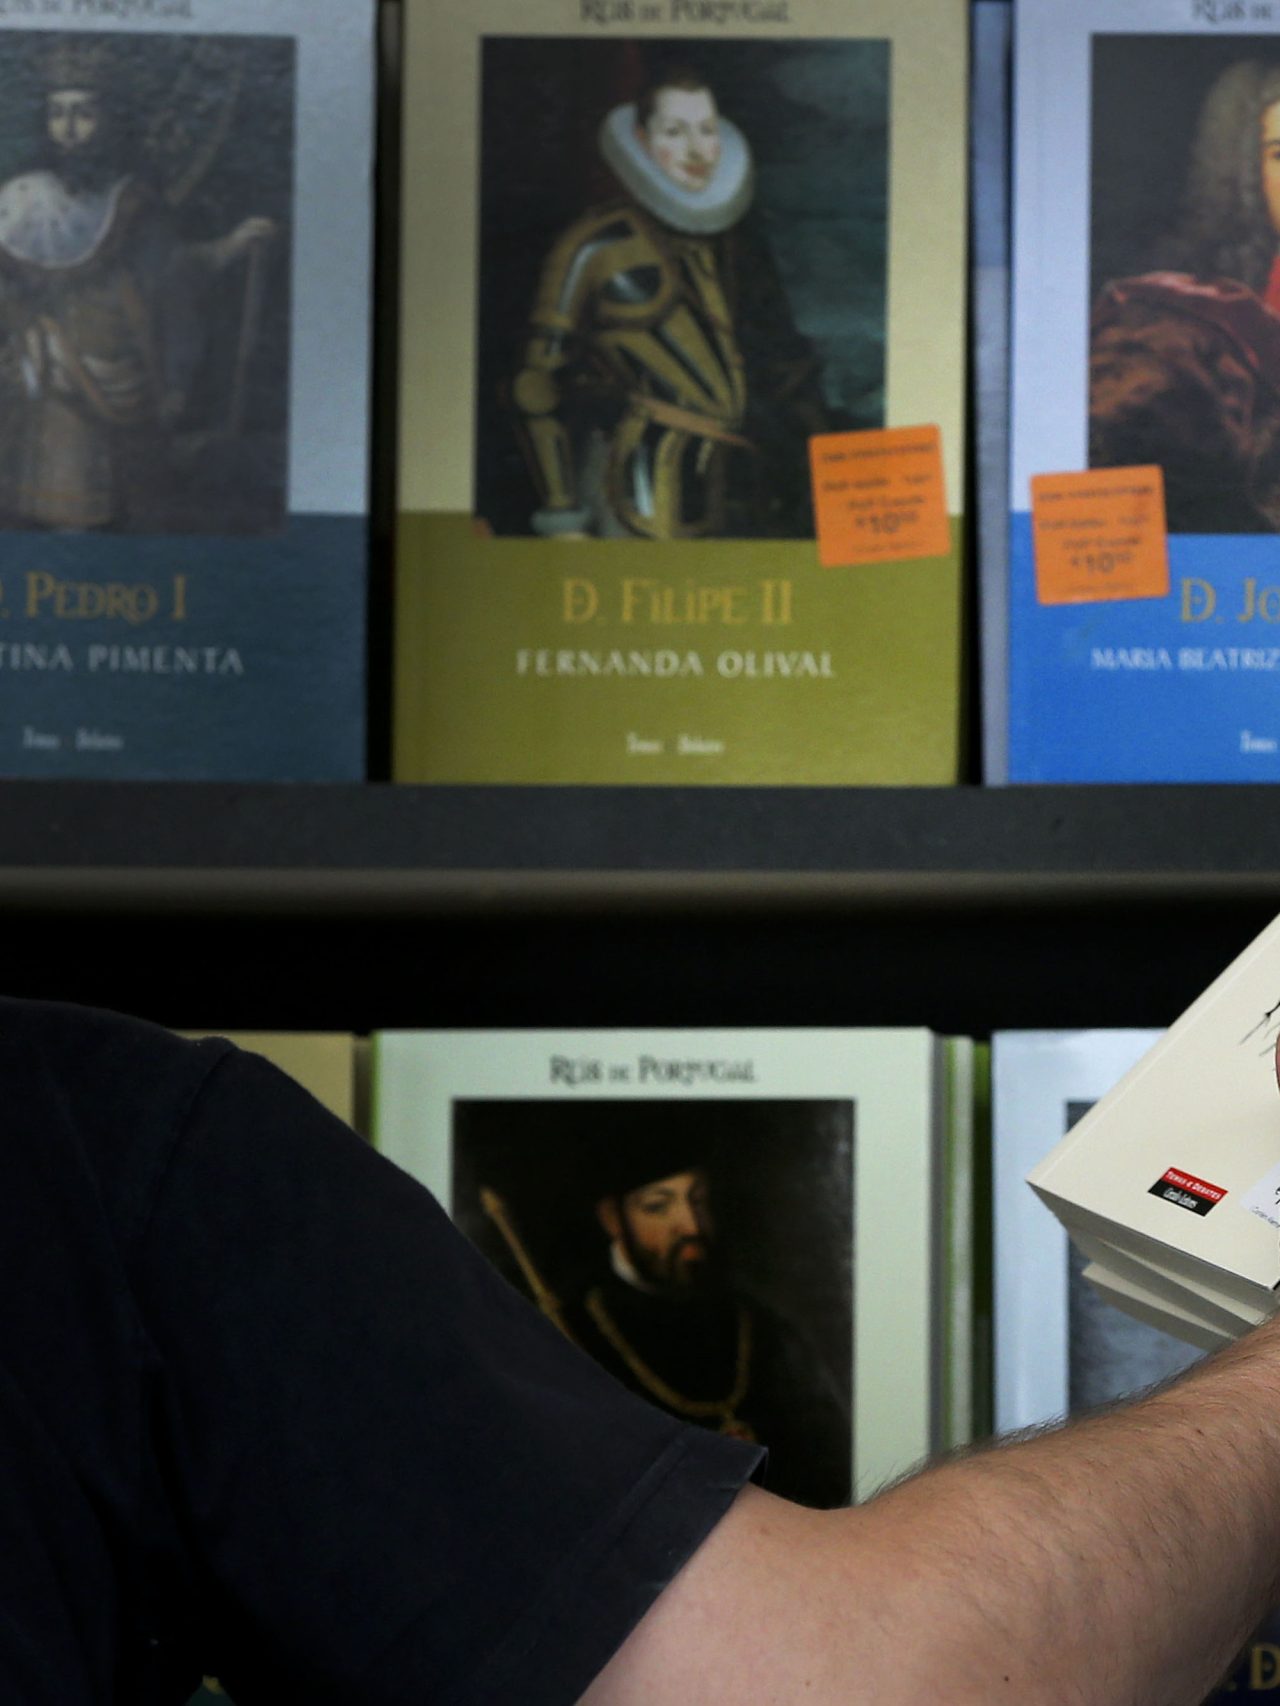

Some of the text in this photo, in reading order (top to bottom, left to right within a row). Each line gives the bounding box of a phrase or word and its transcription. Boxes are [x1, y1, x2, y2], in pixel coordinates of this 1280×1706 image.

[26, 571, 158, 625] PEDRO
[171, 573, 187, 620] I
[563, 577, 606, 625] D.
[761, 578, 793, 625] II
[1180, 576, 1226, 624] D.
[88, 642, 245, 675] PIMENTA
[516, 649, 835, 678] FERNANDA OLIVAL
[1091, 648, 1173, 671] MARIA
